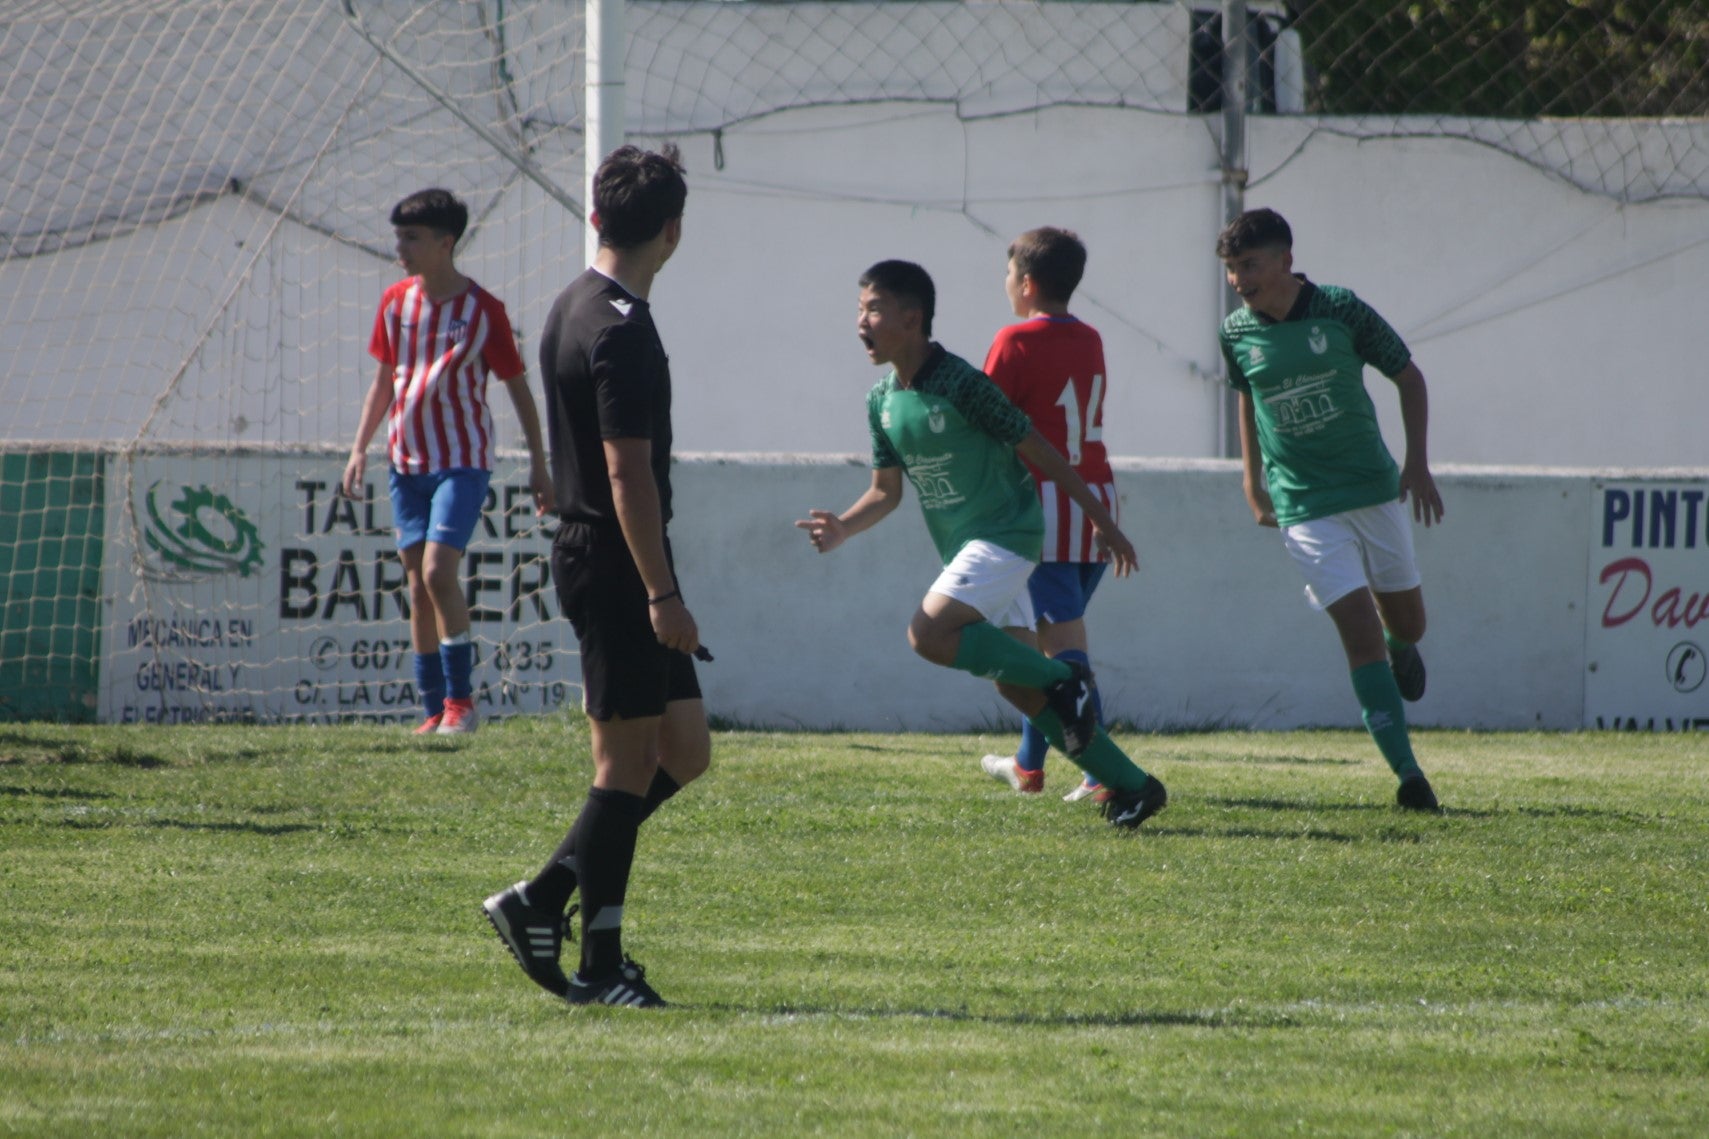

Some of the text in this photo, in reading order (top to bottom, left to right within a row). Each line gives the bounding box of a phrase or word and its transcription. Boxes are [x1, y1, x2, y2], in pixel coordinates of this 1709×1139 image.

[1055, 373, 1103, 465] 14
[1602, 488, 1709, 549] PINT
[228, 619, 253, 648] EN
[350, 639, 410, 671] 607
[493, 639, 554, 671] 835
[228, 662, 241, 691] Y
[337, 679, 371, 706] LA
[541, 681, 566, 706] 19
